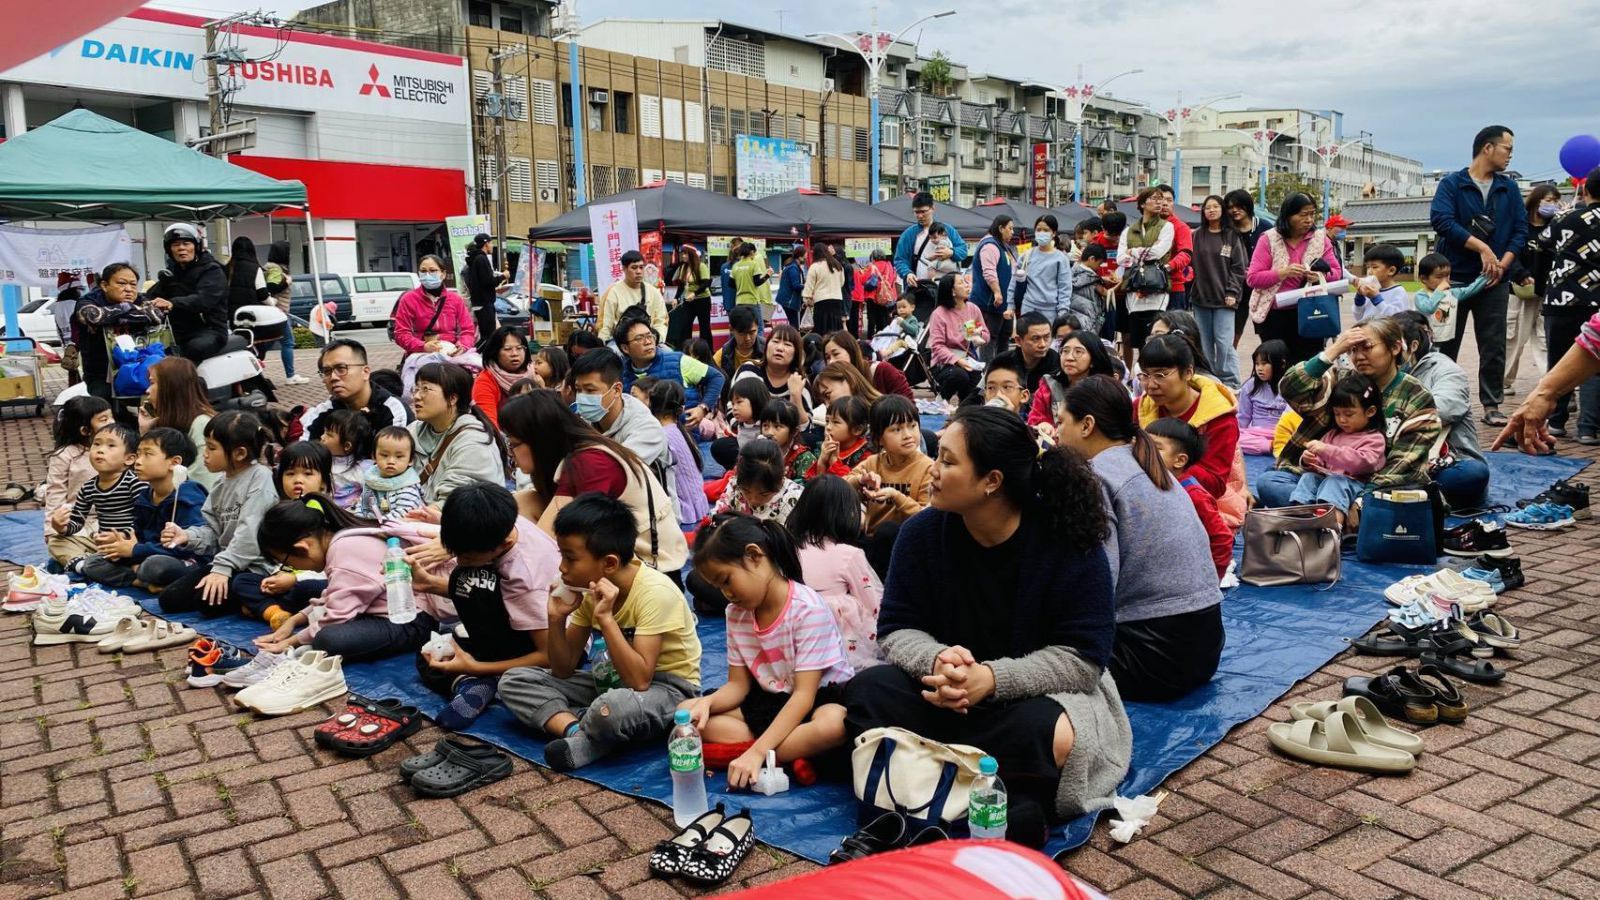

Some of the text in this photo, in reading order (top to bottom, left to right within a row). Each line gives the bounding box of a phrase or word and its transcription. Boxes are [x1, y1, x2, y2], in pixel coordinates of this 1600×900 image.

[81, 39, 194, 71] DAIKIN
[227, 59, 334, 89] TOSHIBA
[393, 74, 455, 94] MITSUBISHI
[394, 87, 447, 105] ELECTRIC
[607, 232, 623, 281] 門諾基
